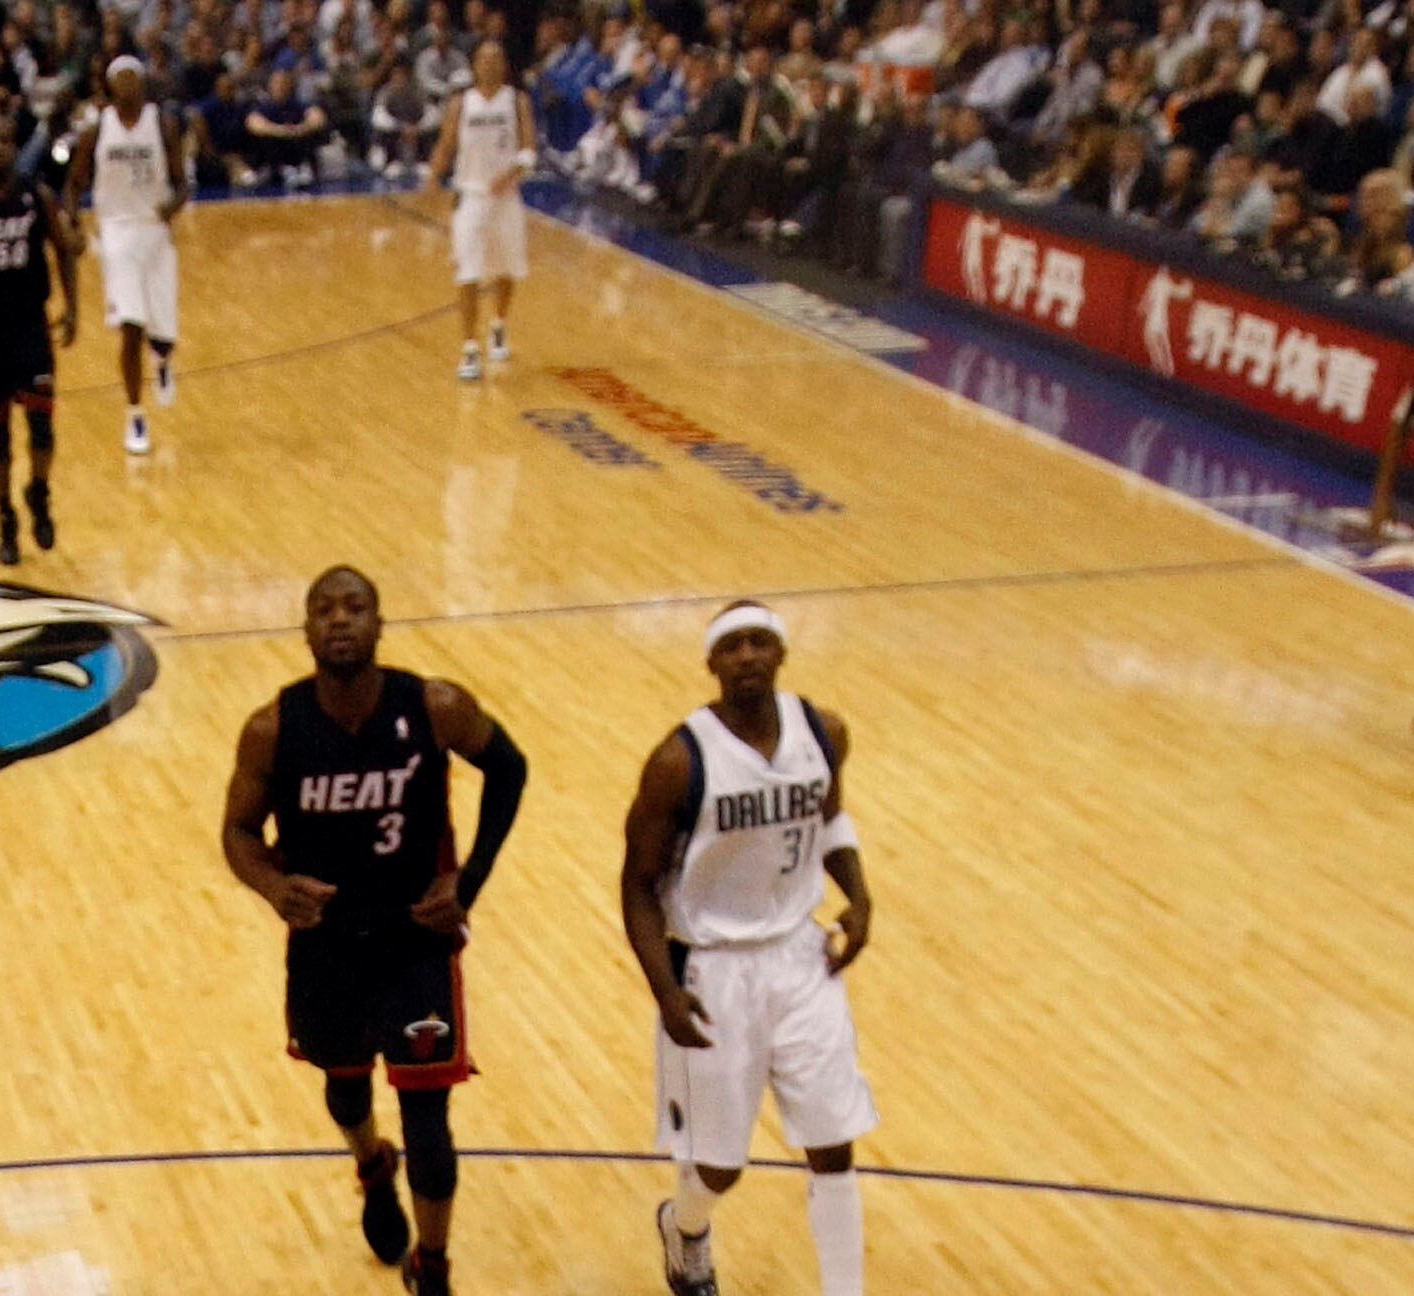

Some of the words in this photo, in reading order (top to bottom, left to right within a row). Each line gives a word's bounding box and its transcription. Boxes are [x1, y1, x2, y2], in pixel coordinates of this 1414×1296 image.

[1186, 299, 1380, 424] 乔丹体育
[298, 752, 422, 814] HEAT
[715, 778, 826, 833] DALLAS
[371, 811, 406, 856] 3
[779, 821, 817, 876] 31
